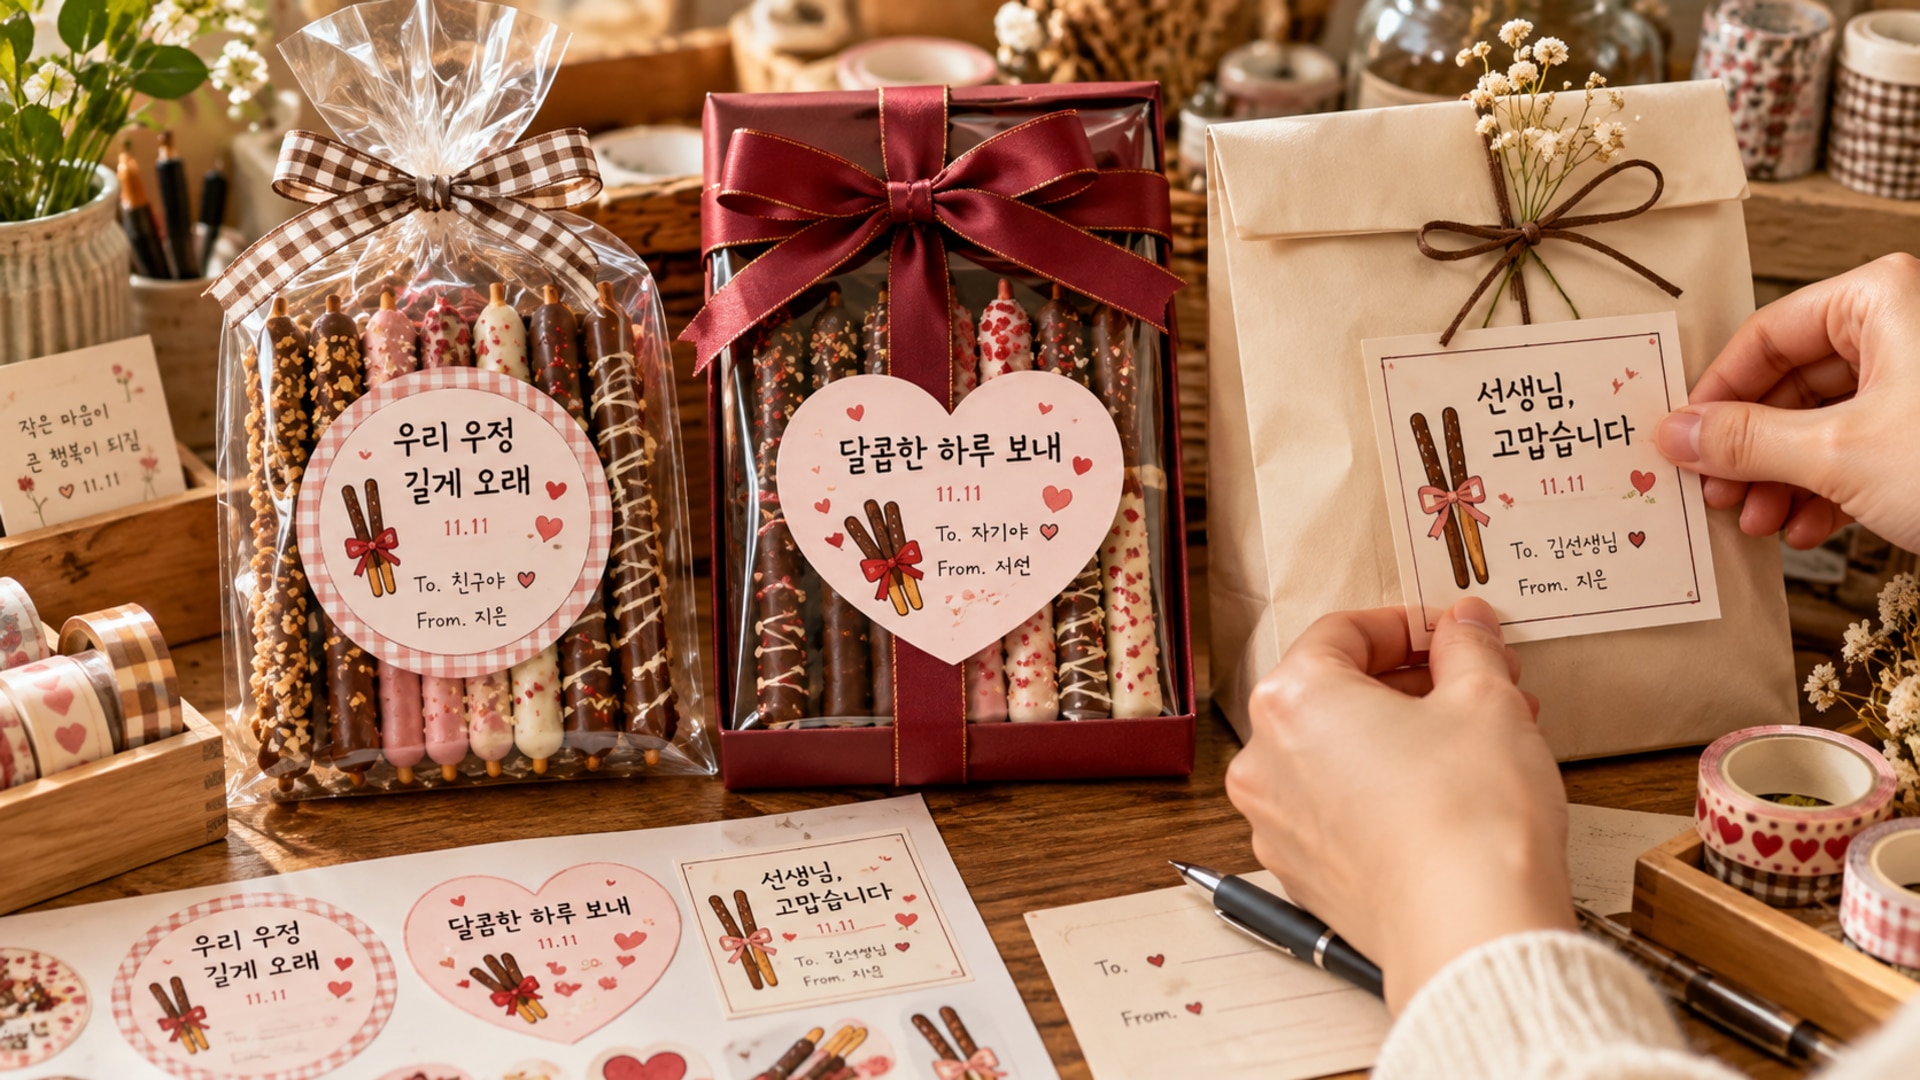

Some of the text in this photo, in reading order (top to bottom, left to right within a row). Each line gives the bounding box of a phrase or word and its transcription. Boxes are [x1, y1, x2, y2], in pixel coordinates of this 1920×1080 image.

[1478, 372, 1574, 415] 선생님,
[19, 415, 52, 438] 작은
[394, 417, 512, 457] 우리 우정
[1493, 415, 1635, 460] 고맙습니다
[938, 434, 994, 468] 하루
[1006, 432, 1060, 463] 보내
[27, 453, 42, 473] 큰
[83, 472, 120, 493] 11.11
[405, 465, 530, 505] 길게 오래
[937, 485, 980, 502] 11.11
[1541, 475, 1584, 495] 11.11
[445, 518, 487, 536] 11.11
[935, 523, 1028, 542] To. 자기야
[1510, 532, 1617, 559] To. 김선생님
[938, 560, 985, 576] From.
[414, 572, 505, 594] To. 친구야
[1519, 569, 1607, 596] From. 지은
[417, 606, 506, 629] From. 지은
[761, 861, 842, 891] 선생님,
[776, 882, 893, 916] 고맙습니다
[448, 896, 631, 941] 달콤한 하루 보내
[817, 919, 855, 934] 11.11
[192, 920, 299, 957] 우리 우정
[538, 935, 577, 949] 11.11
[205, 950, 319, 988] 길게 오래
[794, 955, 819, 967] To.
[1094, 960, 1128, 975] To.
[803, 975, 845, 987] From.
[246, 989, 285, 1005] 11.11
[1121, 1010, 1176, 1026] From.
